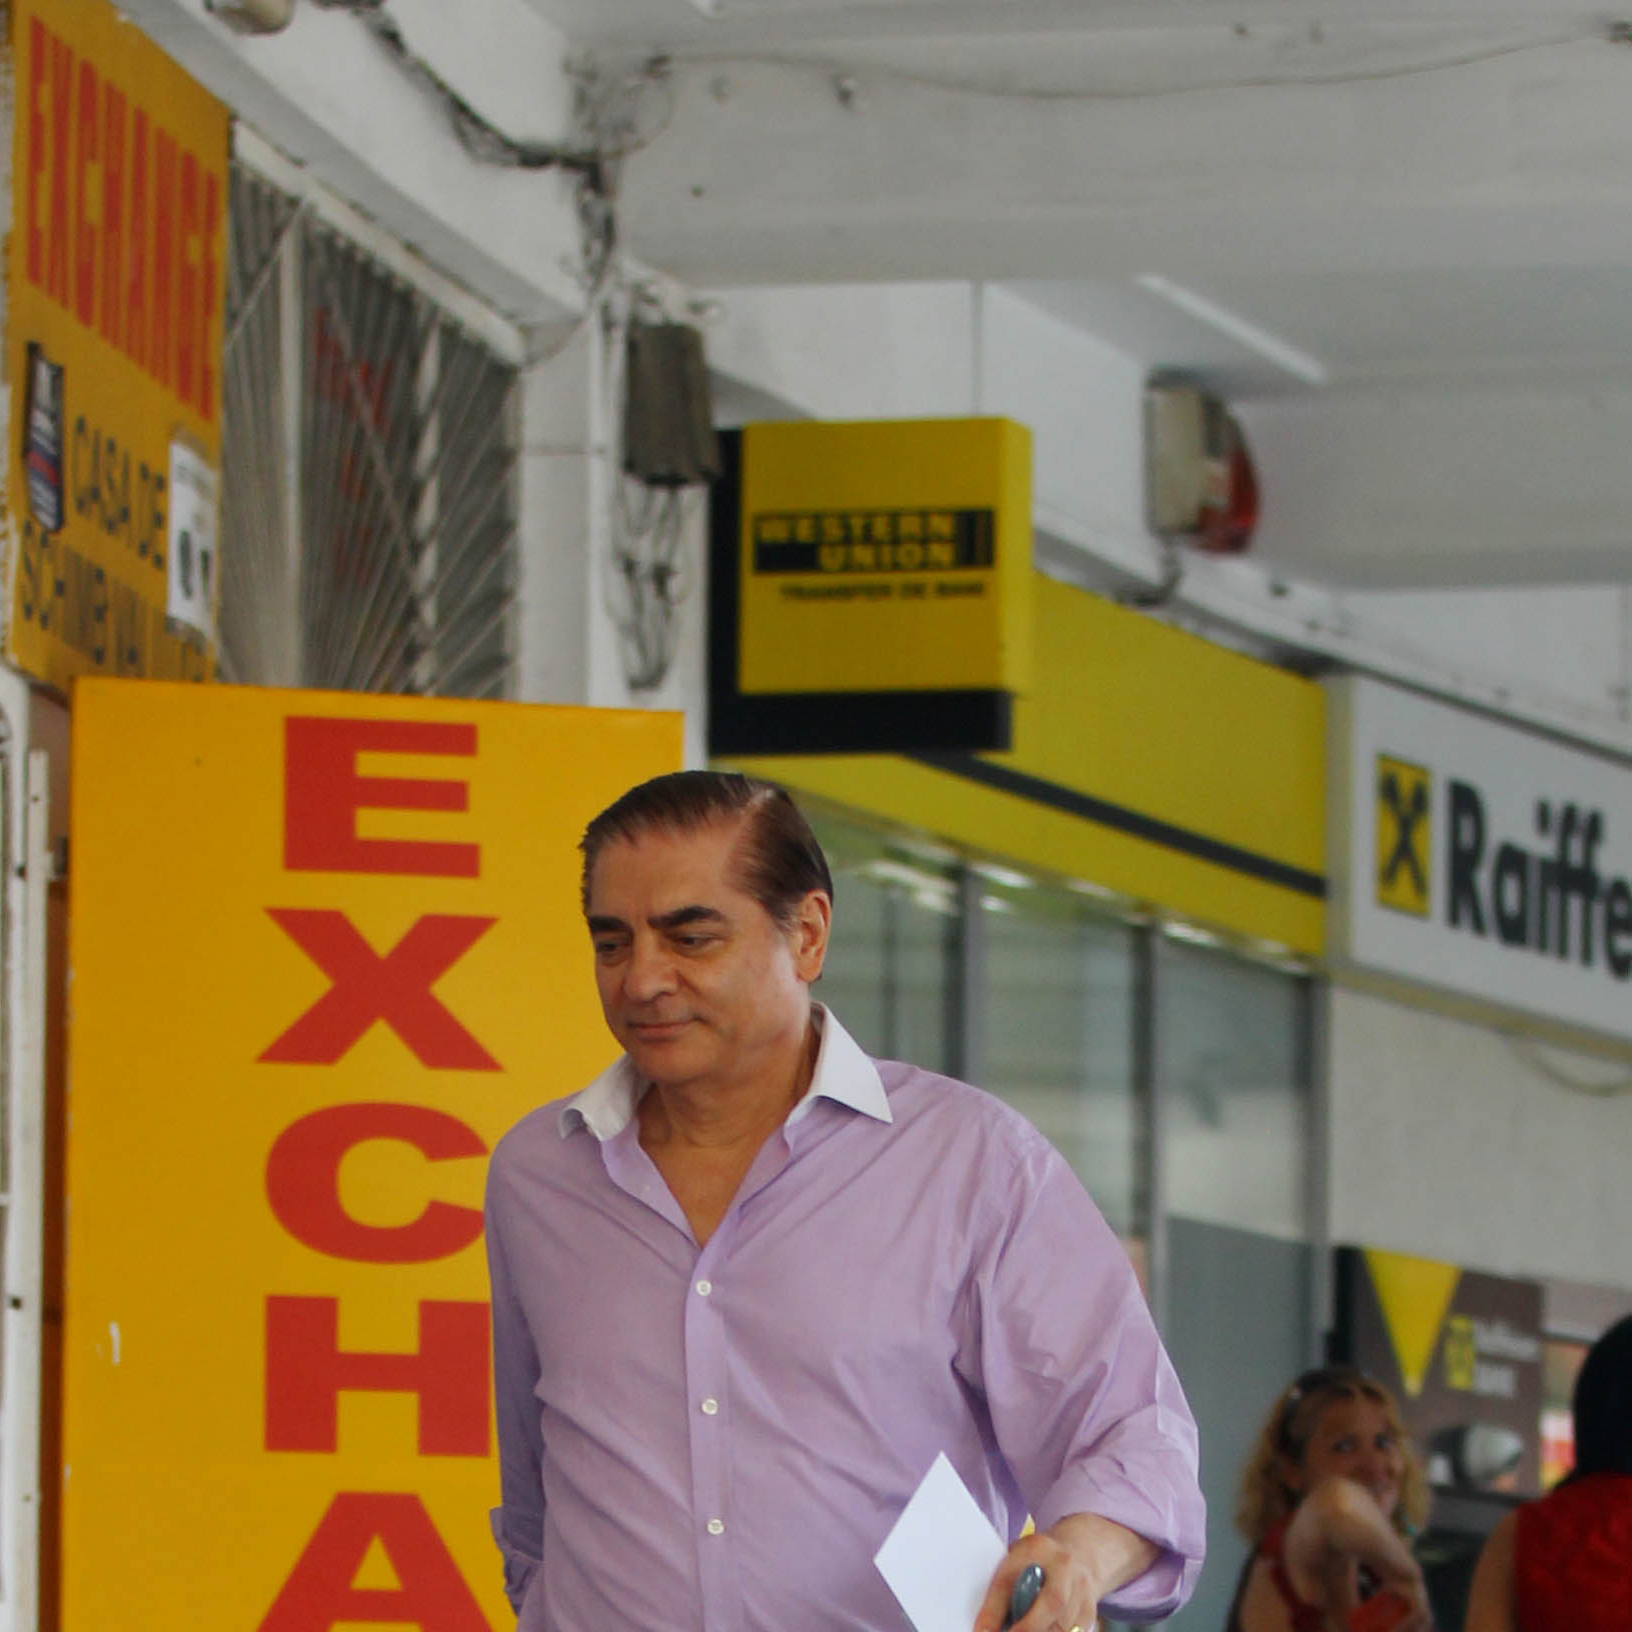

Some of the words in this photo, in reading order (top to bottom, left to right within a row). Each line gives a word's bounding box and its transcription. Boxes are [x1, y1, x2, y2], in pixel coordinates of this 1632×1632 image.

[758, 512, 954, 543] WESTERN
[818, 543, 954, 572] UNION
[1445, 775, 1632, 982] Raiffe
